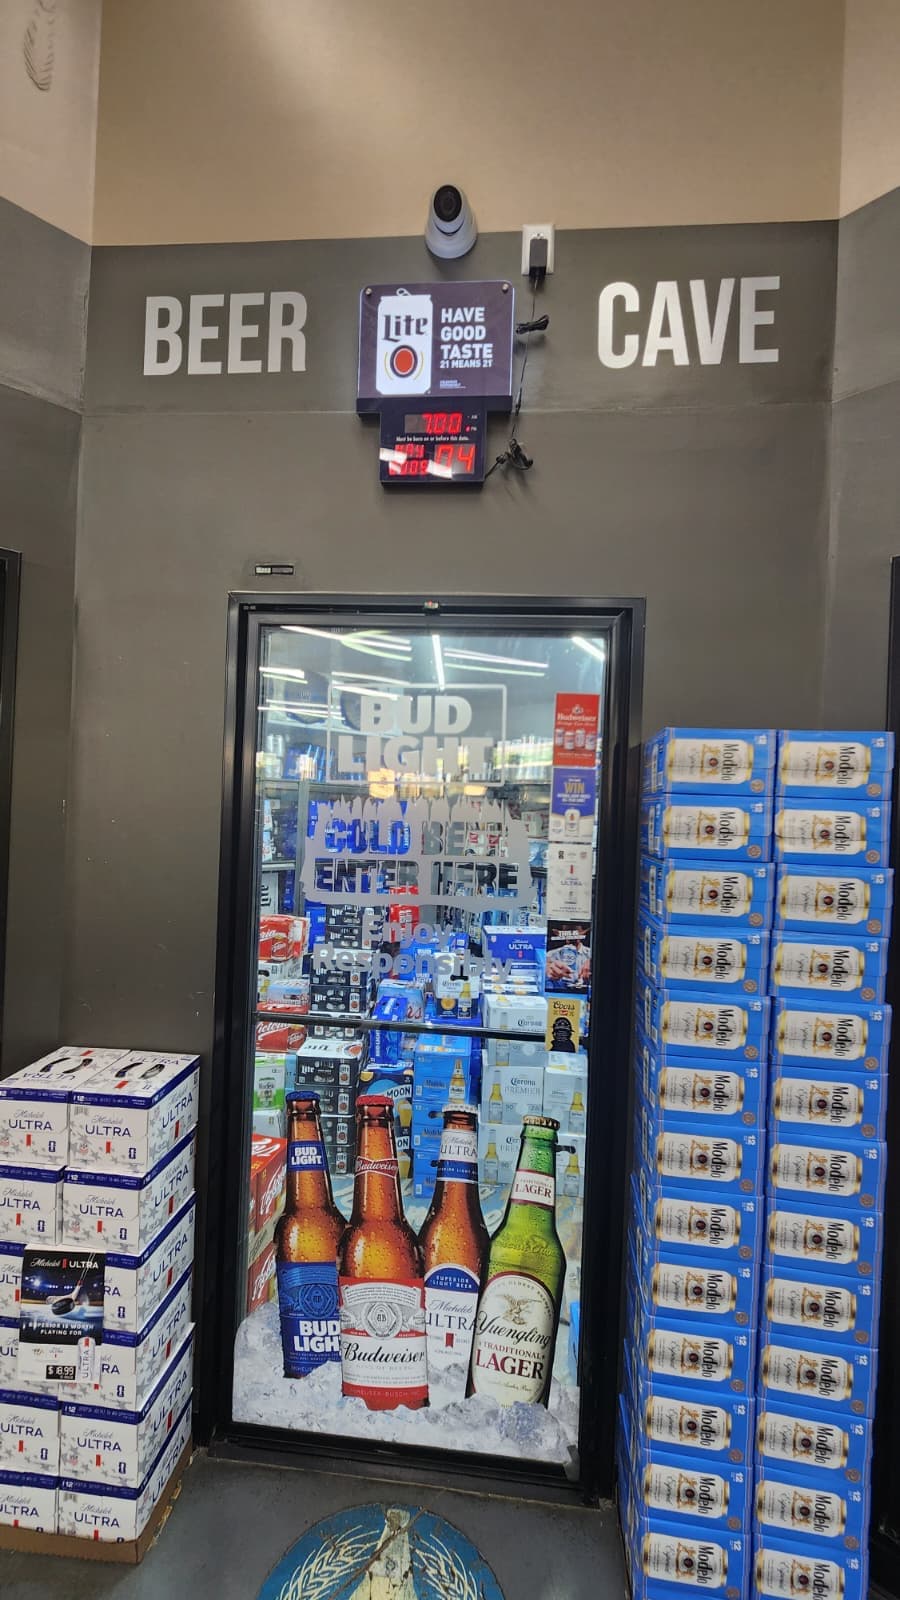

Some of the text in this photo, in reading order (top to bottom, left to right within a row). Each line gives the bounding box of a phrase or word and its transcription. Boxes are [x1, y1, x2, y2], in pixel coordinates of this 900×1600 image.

[382, 314, 428, 342] Lite
[440, 307, 485, 323] HAVE
[598, 276, 780, 369] CAVE
[143, 291, 307, 376] BEER
[440, 325, 486, 341] GOOD
[440, 343, 493, 359] TASTE
[440, 359, 493, 369] 21 MEANS 21
[360, 695, 472, 734] BUD
[338, 735, 494, 775] LIGHT
[721, 743, 739, 781] Modelo
[837, 746, 856, 785] Modelo
[564, 782, 585, 793] WIN
[325, 818, 509, 857] COLD BEER
[719, 811, 735, 847] Modelo
[835, 816, 851, 851] Modelo
[314, 857, 519, 897] ENTER HERE
[721, 875, 739, 913] Modelo
[837, 881, 855, 920] Modelo
[362, 914, 452, 950] Enjoy
[313, 943, 512, 982] Responsibly
[716, 942, 733, 980] Modelo
[830, 949, 850, 988] Modelo
[716, 1008, 734, 1047] Modelo
[834, 1018, 853, 1056] Modelo
[301, 1065, 314, 1074] Lite
[511, 1078, 536, 1086] Corona
[750, 1068, 758, 1078] 12
[713, 1075, 730, 1111] Modelo
[870, 1080, 878, 1089] 12
[162, 1092, 193, 1128] ULTRA
[830, 1086, 849, 1123] Modelo
[8, 1119, 53, 1131] ULTRA
[85, 1126, 131, 1137] ULTRA
[295, 1147, 317, 1155] BUD
[397, 1139, 409, 1150] ON
[748, 1135, 756, 1145] 12
[869, 1149, 877, 1159] 12
[291, 1154, 322, 1166] LIGHT
[356, 1158, 398, 1171] Budweiser
[711, 1141, 728, 1178] Modelo
[828, 1155, 848, 1192] Modelo
[154, 1164, 189, 1208] ULTRA
[515, 1184, 552, 1198] LAGER
[0, 1198, 41, 1210] ULTRA
[79, 1204, 124, 1217] ULTRA
[746, 1202, 754, 1212] 12
[710, 1208, 727, 1245] Modelo
[866, 1217, 874, 1227] 12
[826, 1222, 844, 1260] Modelo
[69, 1258, 99, 1269] ULTRA
[153, 1234, 188, 1282] ULTRA
[0, 1273, 20, 1285] ULT
[436, 1275, 469, 1284] SUPERIOR
[743, 1268, 750, 1278] 12
[706, 1273, 723, 1310] Modelo
[863, 1285, 870, 1295] 12
[823, 1289, 842, 1328] Modelo
[152, 1303, 186, 1358] ULTRA
[299, 1320, 341, 1336] BUD
[476, 1311, 551, 1349] Yuengling
[739, 1336, 747, 1346] 12
[294, 1336, 342, 1353] LIGH
[342, 1341, 424, 1363] Budweiser
[484, 1341, 542, 1360] TRADITIONAL
[476, 1349, 544, 1379] LAGER
[702, 1340, 719, 1378] Modelo
[860, 1355, 867, 1366] 12
[820, 1359, 839, 1397] Modelo
[154, 1373, 188, 1433] ULTRA
[738, 1405, 745, 1415] 12
[0, 1423, 44, 1437] ULTRA
[700, 1409, 717, 1446] Modelo
[855, 1424, 863, 1435] 12
[77, 1437, 122, 1452] ULTRA
[814, 1426, 834, 1464] Modelo
[152, 1436, 185, 1503] ULTRA
[736, 1472, 743, 1482] 12
[698, 1476, 715, 1514] Modelo
[853, 1491, 861, 1501] 12
[74, 1512, 120, 1528] ULTRA
[814, 1494, 832, 1533] Modelo
[734, 1540, 741, 1551] 12
[696, 1544, 714, 1585] Modelo
[851, 1558, 858, 1569] 12
[812, 1562, 830, 1600] Modelo
